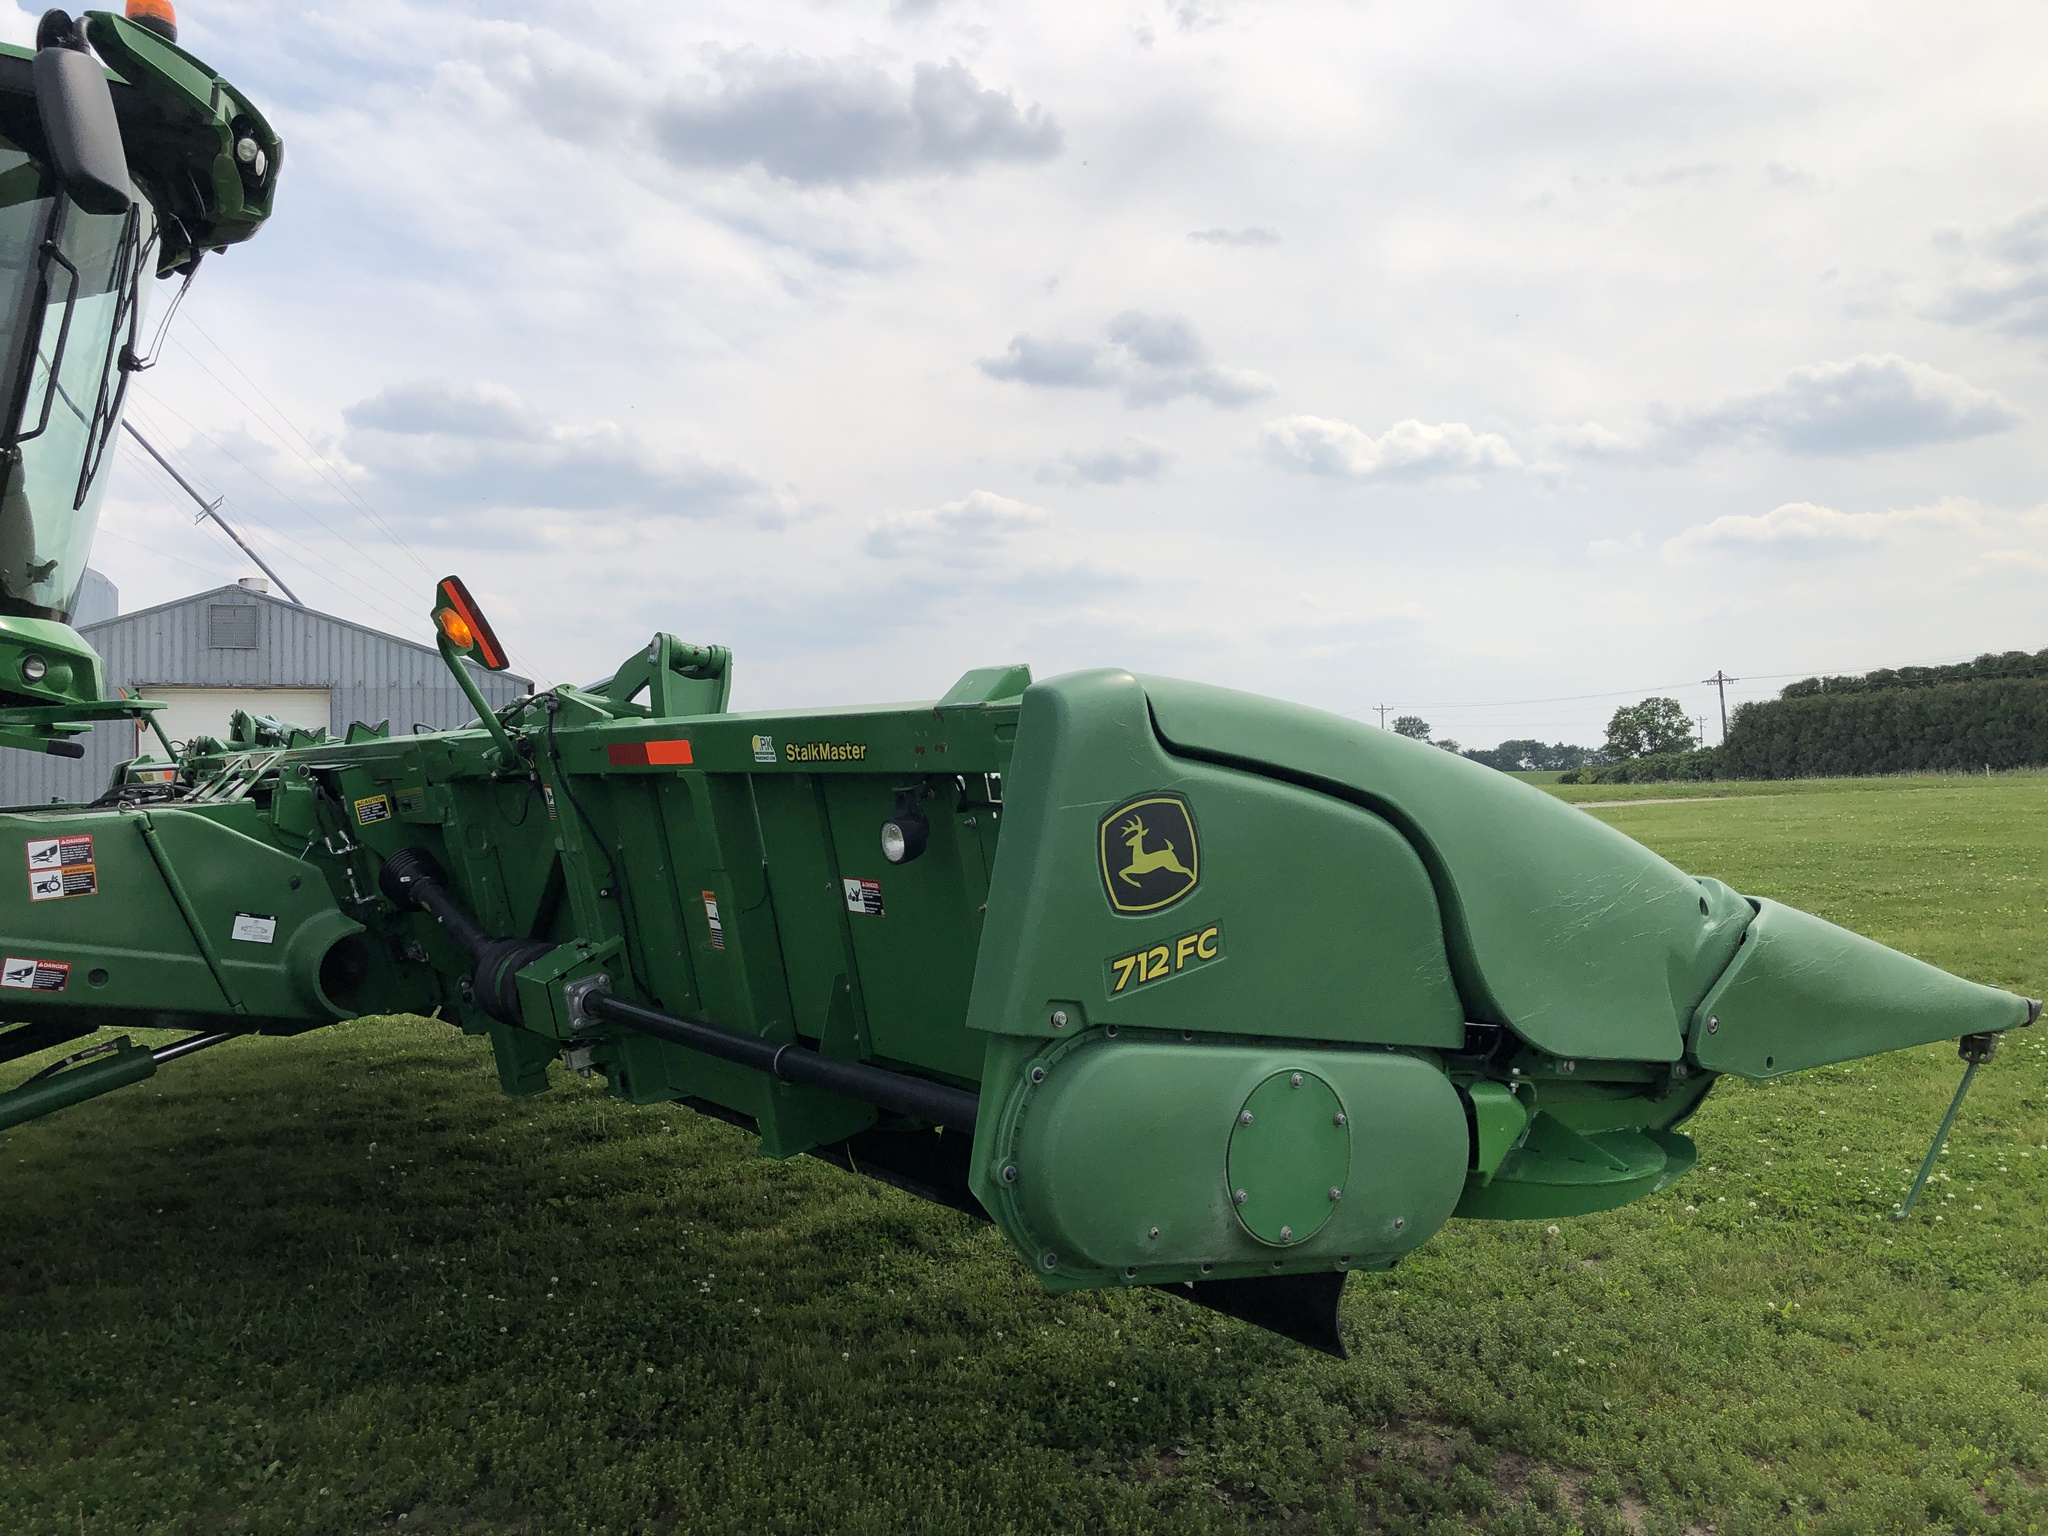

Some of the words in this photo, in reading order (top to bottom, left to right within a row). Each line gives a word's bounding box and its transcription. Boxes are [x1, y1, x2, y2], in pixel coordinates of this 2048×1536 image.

[786, 742, 866, 761] StalkMaster
[360, 795, 385, 806] CAUTION
[43, 962, 69, 970] DANGER
[1113, 946, 1170, 991] 712
[1176, 927, 1218, 969] FC
